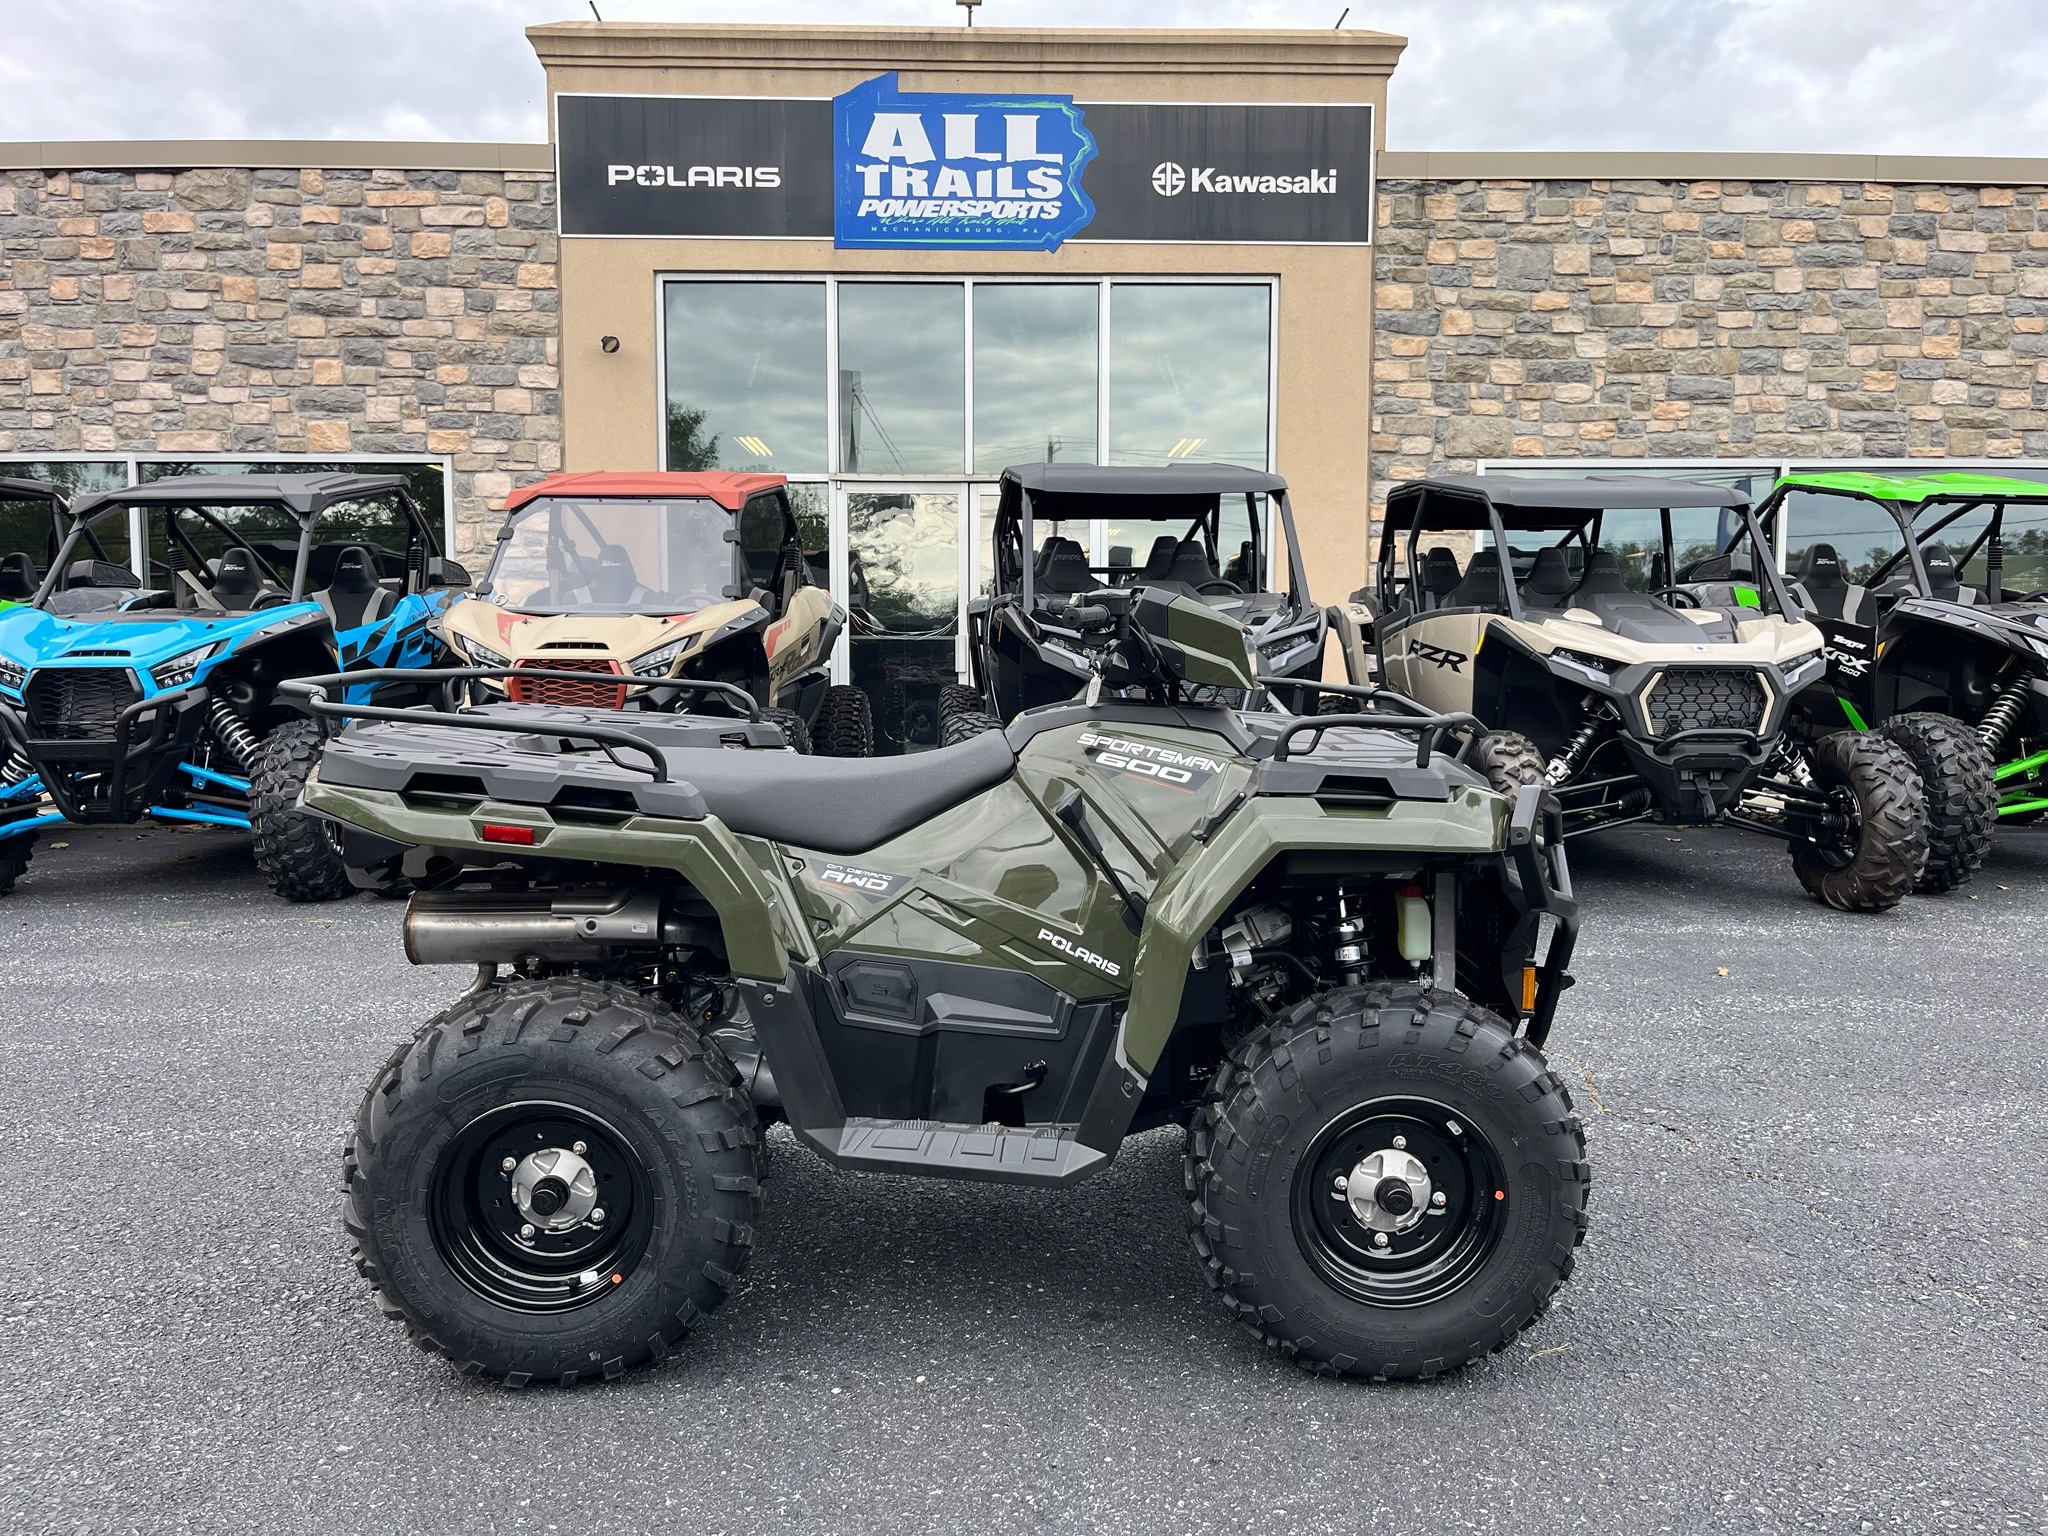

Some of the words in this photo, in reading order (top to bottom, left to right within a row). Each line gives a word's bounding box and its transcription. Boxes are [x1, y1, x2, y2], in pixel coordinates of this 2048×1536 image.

[860, 112, 1063, 165] ALL
[607, 164, 781, 188] POLARIS
[855, 164, 1063, 199] TRAILS
[1191, 167, 1337, 194] Kawasaki
[856, 199, 1063, 219] POWERSPORTS
[880, 215, 924, 225] Where
[926, 215, 955, 225] All
[957, 215, 994, 226] Trails
[1408, 639, 1468, 674] RZR
[1838, 664, 1861, 677] 1000
[1076, 732, 1226, 774] SPORTSMAN
[1095, 751, 1193, 784] 600
[821, 869, 889, 891] AWD
[1037, 927, 1121, 976] POLARIS
